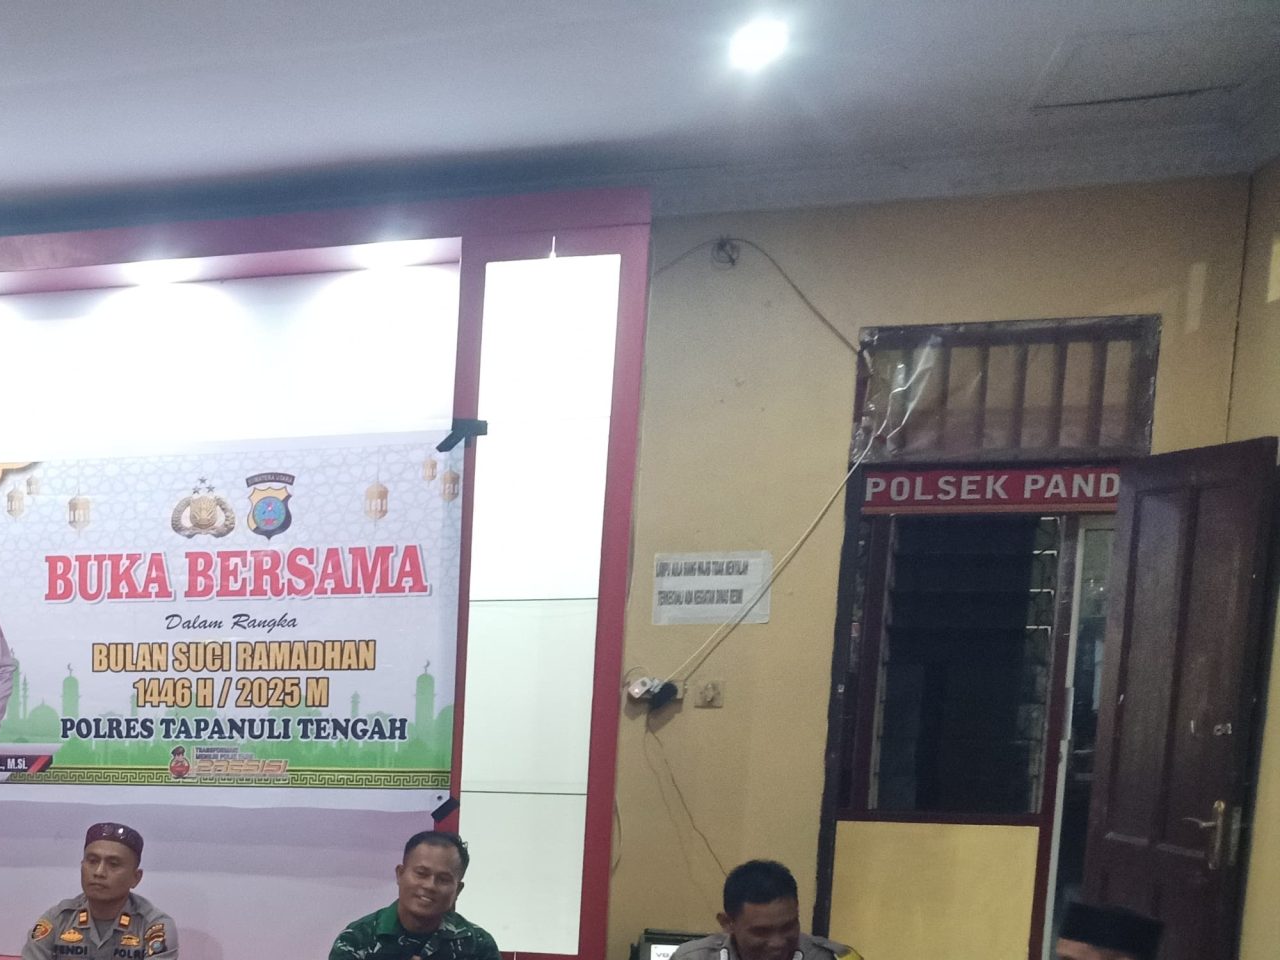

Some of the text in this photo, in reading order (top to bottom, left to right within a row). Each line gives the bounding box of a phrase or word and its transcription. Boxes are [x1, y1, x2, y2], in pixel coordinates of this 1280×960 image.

[865, 475, 1009, 502] POLSEK
[45, 545, 429, 601] BUKA BERSAMA
[165, 612, 298, 633] Dalam Rangka
[92, 640, 376, 672] BULAN SUCI RAMADHAN
[133, 677, 329, 708] 1446 H / 2025 M
[60, 717, 408, 740] POLRES TAPANULI TENGAH
[113, 948, 145, 960] POLRI
